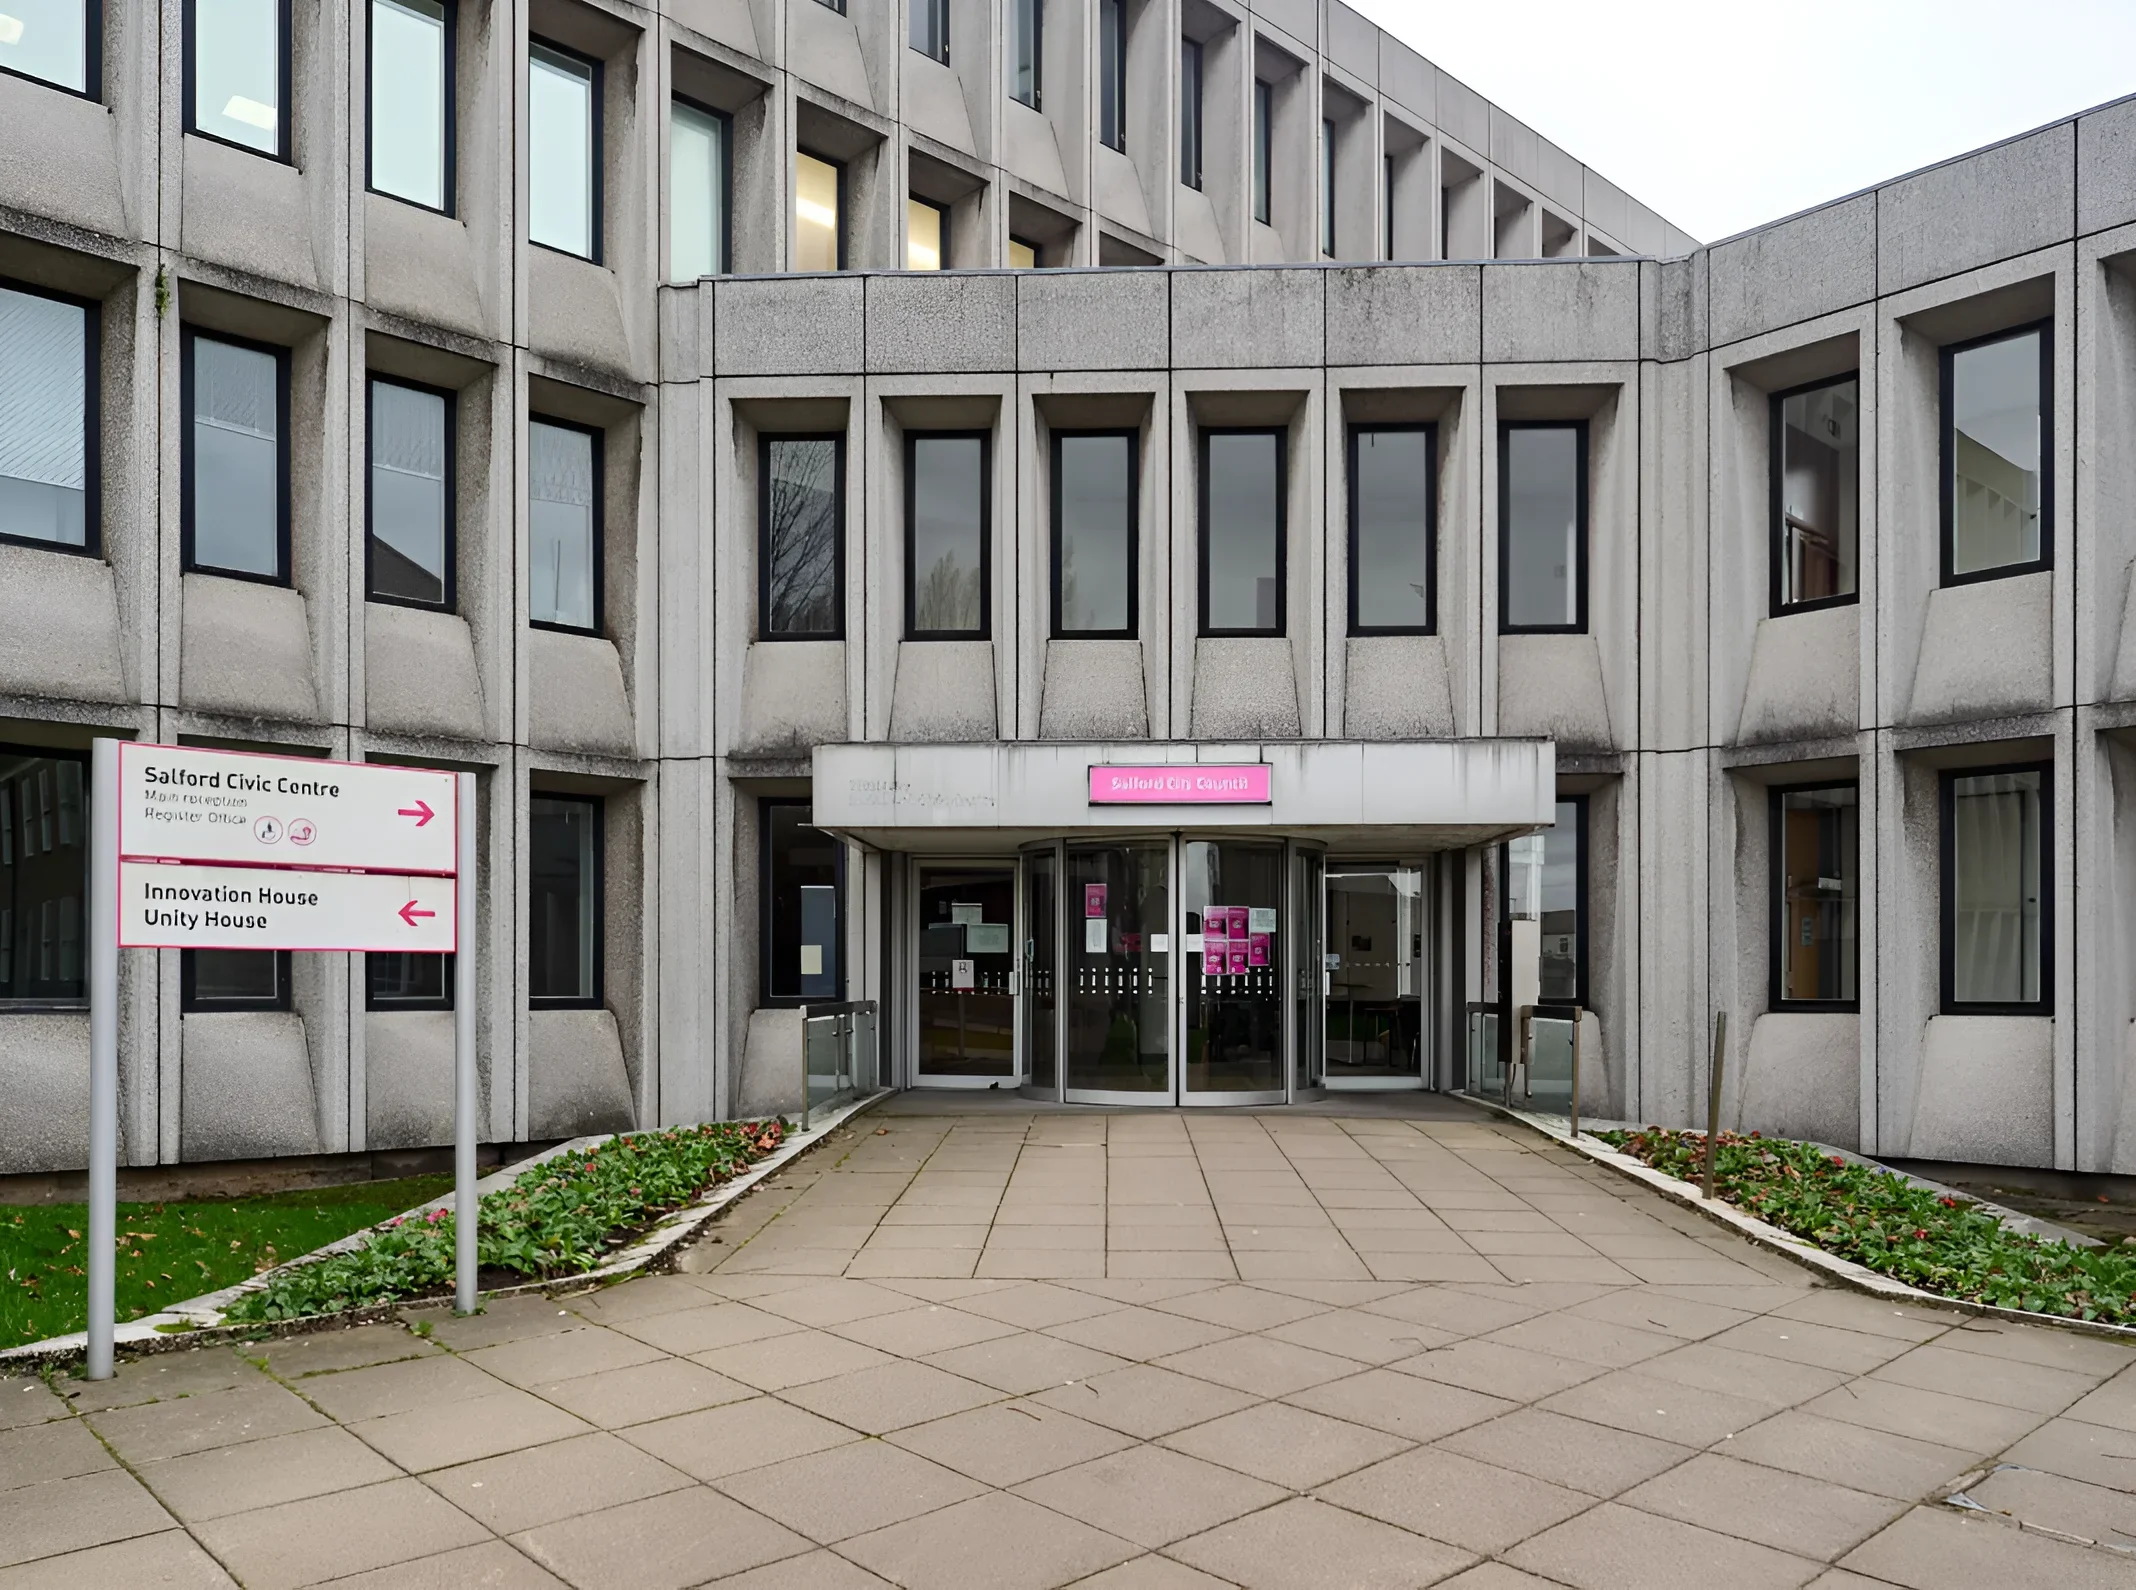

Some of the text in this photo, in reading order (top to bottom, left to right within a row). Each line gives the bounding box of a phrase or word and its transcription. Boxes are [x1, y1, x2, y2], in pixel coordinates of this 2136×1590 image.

[145, 767, 340, 798] Salford Civic Centre
[1111, 776, 1164, 791] Salford
[1196, 776, 1249, 791] Council
[145, 882, 319, 906] Innovation House
[145, 909, 268, 930] Unity House
